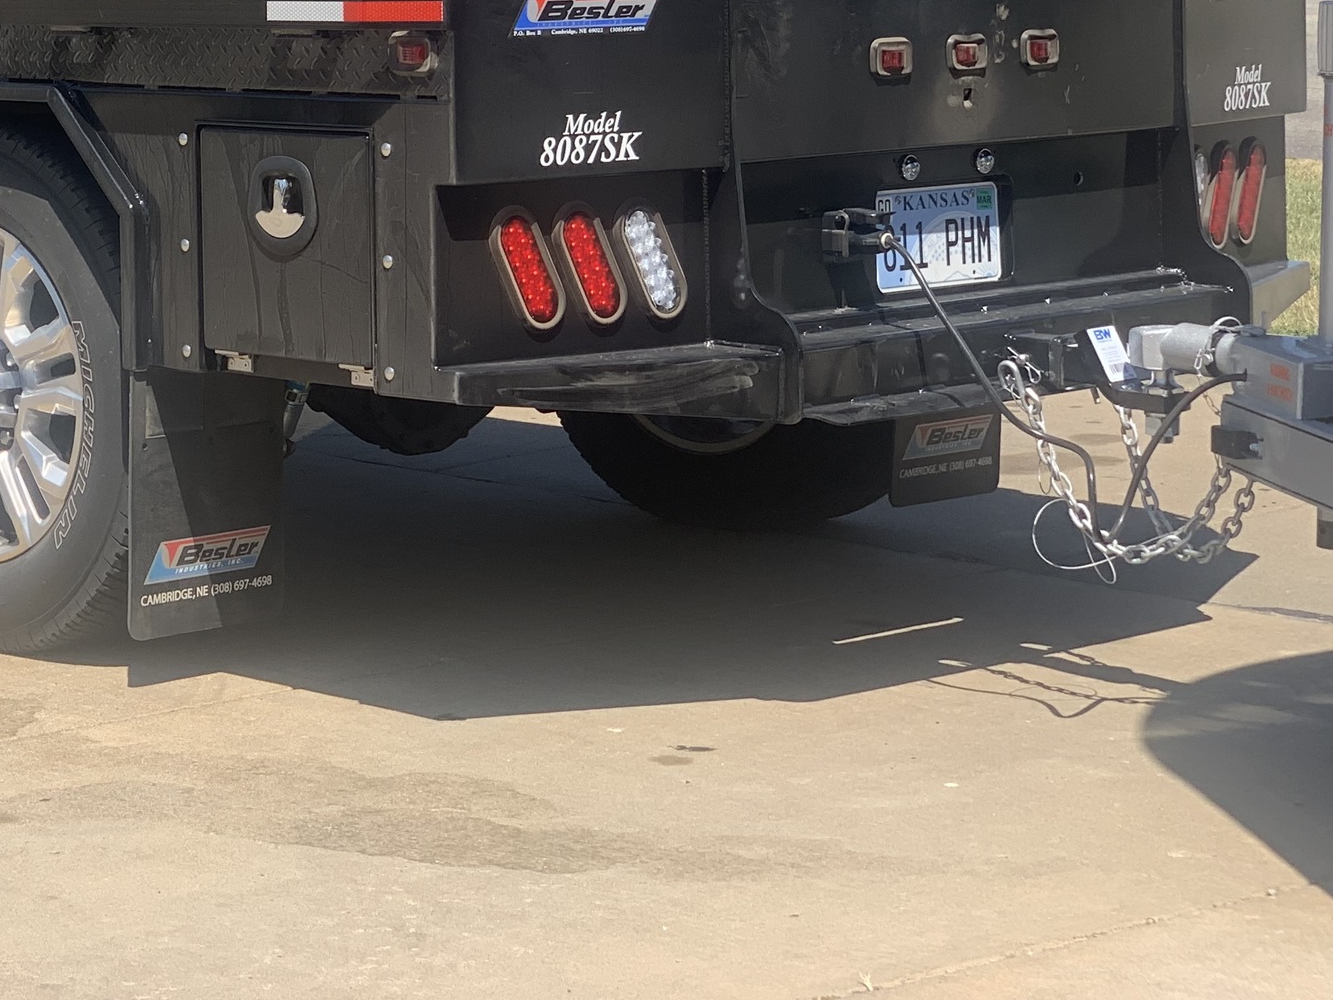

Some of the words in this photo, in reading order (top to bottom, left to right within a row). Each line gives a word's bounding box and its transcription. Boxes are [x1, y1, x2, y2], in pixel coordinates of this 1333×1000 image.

[1235, 64, 1262, 84] Model
[1224, 82, 1271, 111] 8087SK
[563, 110, 622, 135] Model
[539, 131, 642, 167] 8087SK
[902, 191, 970, 211] KANSAS
[977, 195, 992, 204] MAR
[945, 215, 992, 266] PHM
[54, 321, 95, 549] MICHELIN
[927, 424, 984, 445] Besler
[176, 538, 260, 566] Besler
[140, 587, 196, 607] CAMBRIDGE,
[196, 585, 209, 597] NE
[211, 581, 232, 597] (308)
[233, 574, 272, 591] 697-4698
